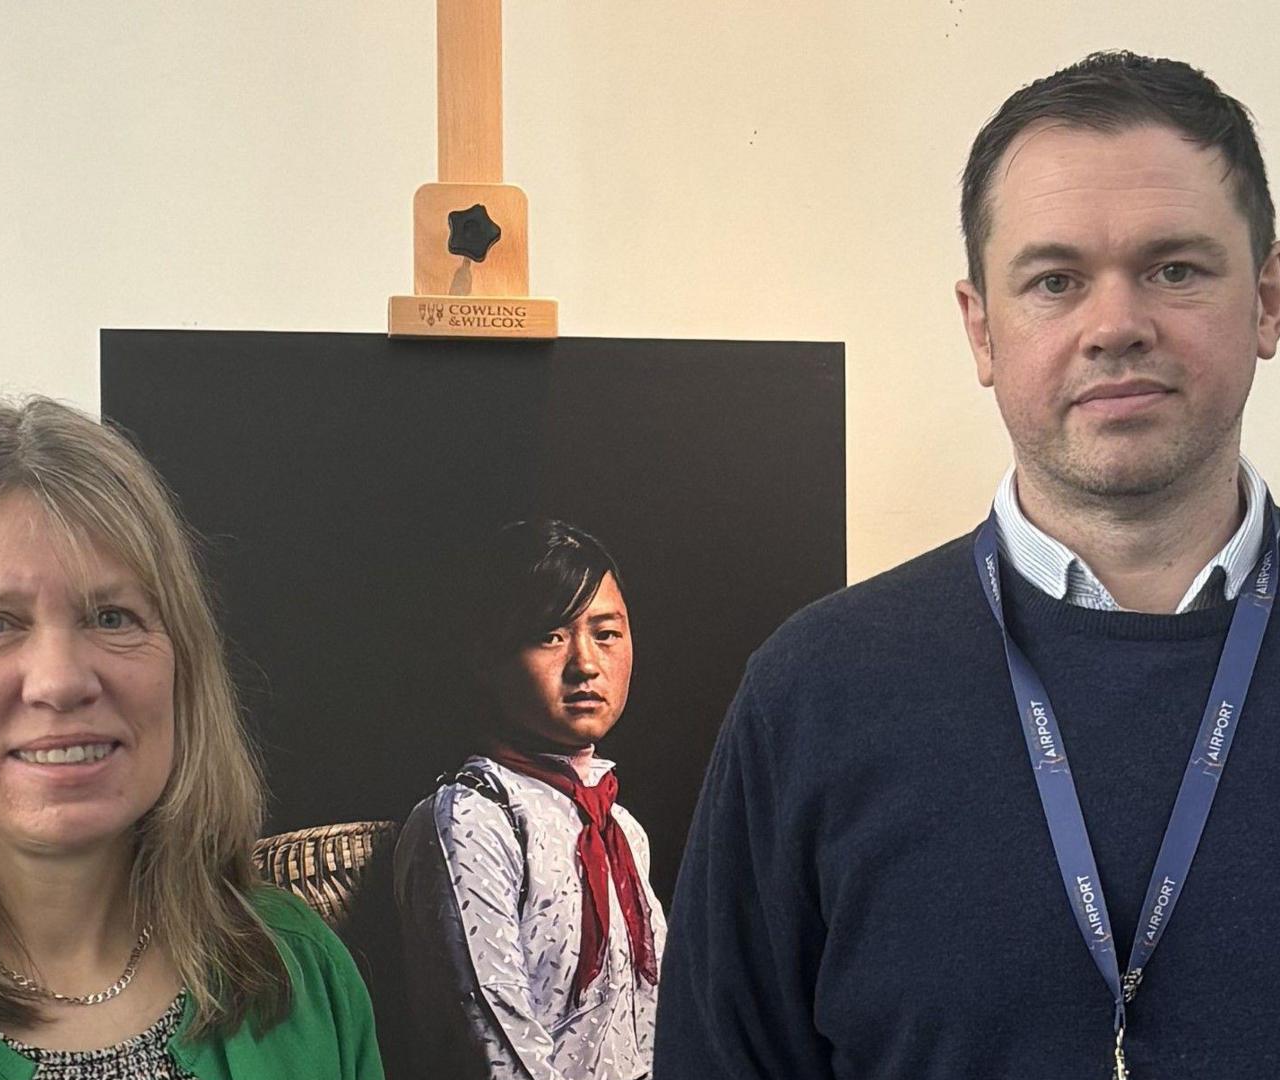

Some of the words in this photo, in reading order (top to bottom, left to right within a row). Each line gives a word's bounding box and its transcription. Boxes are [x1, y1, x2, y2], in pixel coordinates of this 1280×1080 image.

[449, 304, 527, 317] COWLING
[449, 317, 526, 329] &WILCOX
[1030, 700, 1058, 758] AIRPORT
[1207, 700, 1234, 762] AIRPORT
[1077, 875, 1105, 936] AIRPORT
[1145, 876, 1177, 941] AIRPORT
